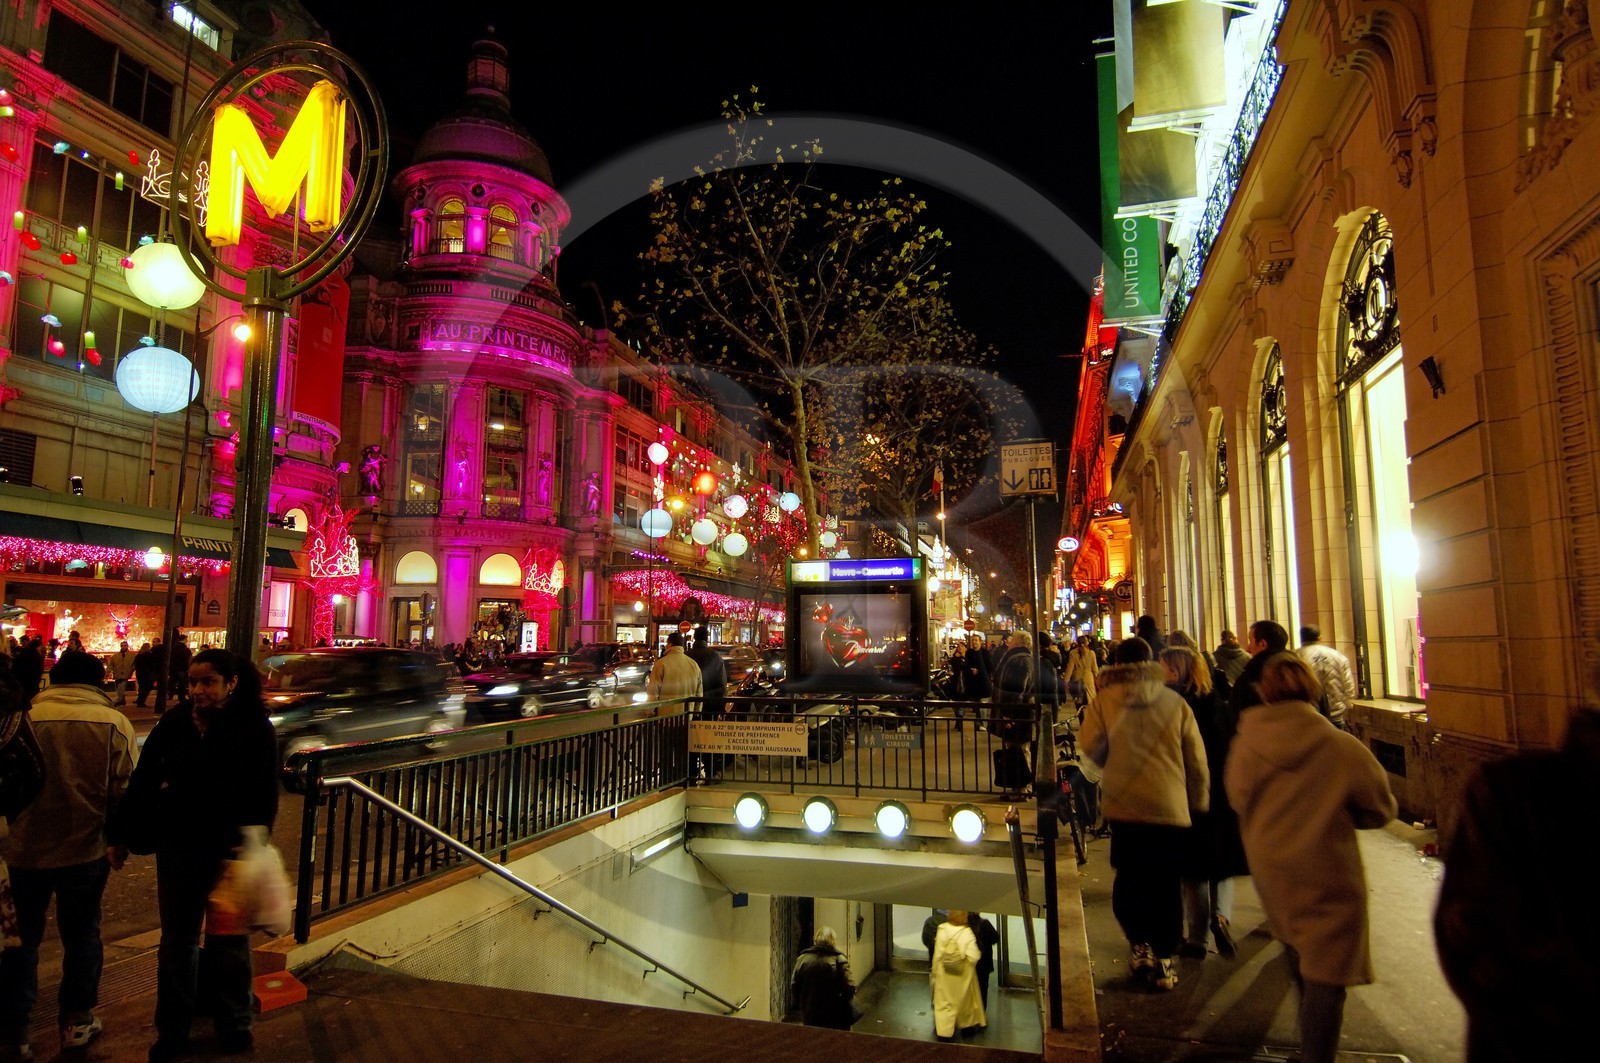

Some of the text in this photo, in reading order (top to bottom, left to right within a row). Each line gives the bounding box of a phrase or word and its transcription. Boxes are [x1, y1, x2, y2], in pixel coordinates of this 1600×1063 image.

[206, 79, 346, 247] M
[1124, 247, 1139, 308] UNITED
[435, 323, 566, 362] AU PRINTEMPS
[1003, 446, 1051, 457] TOILETTES
